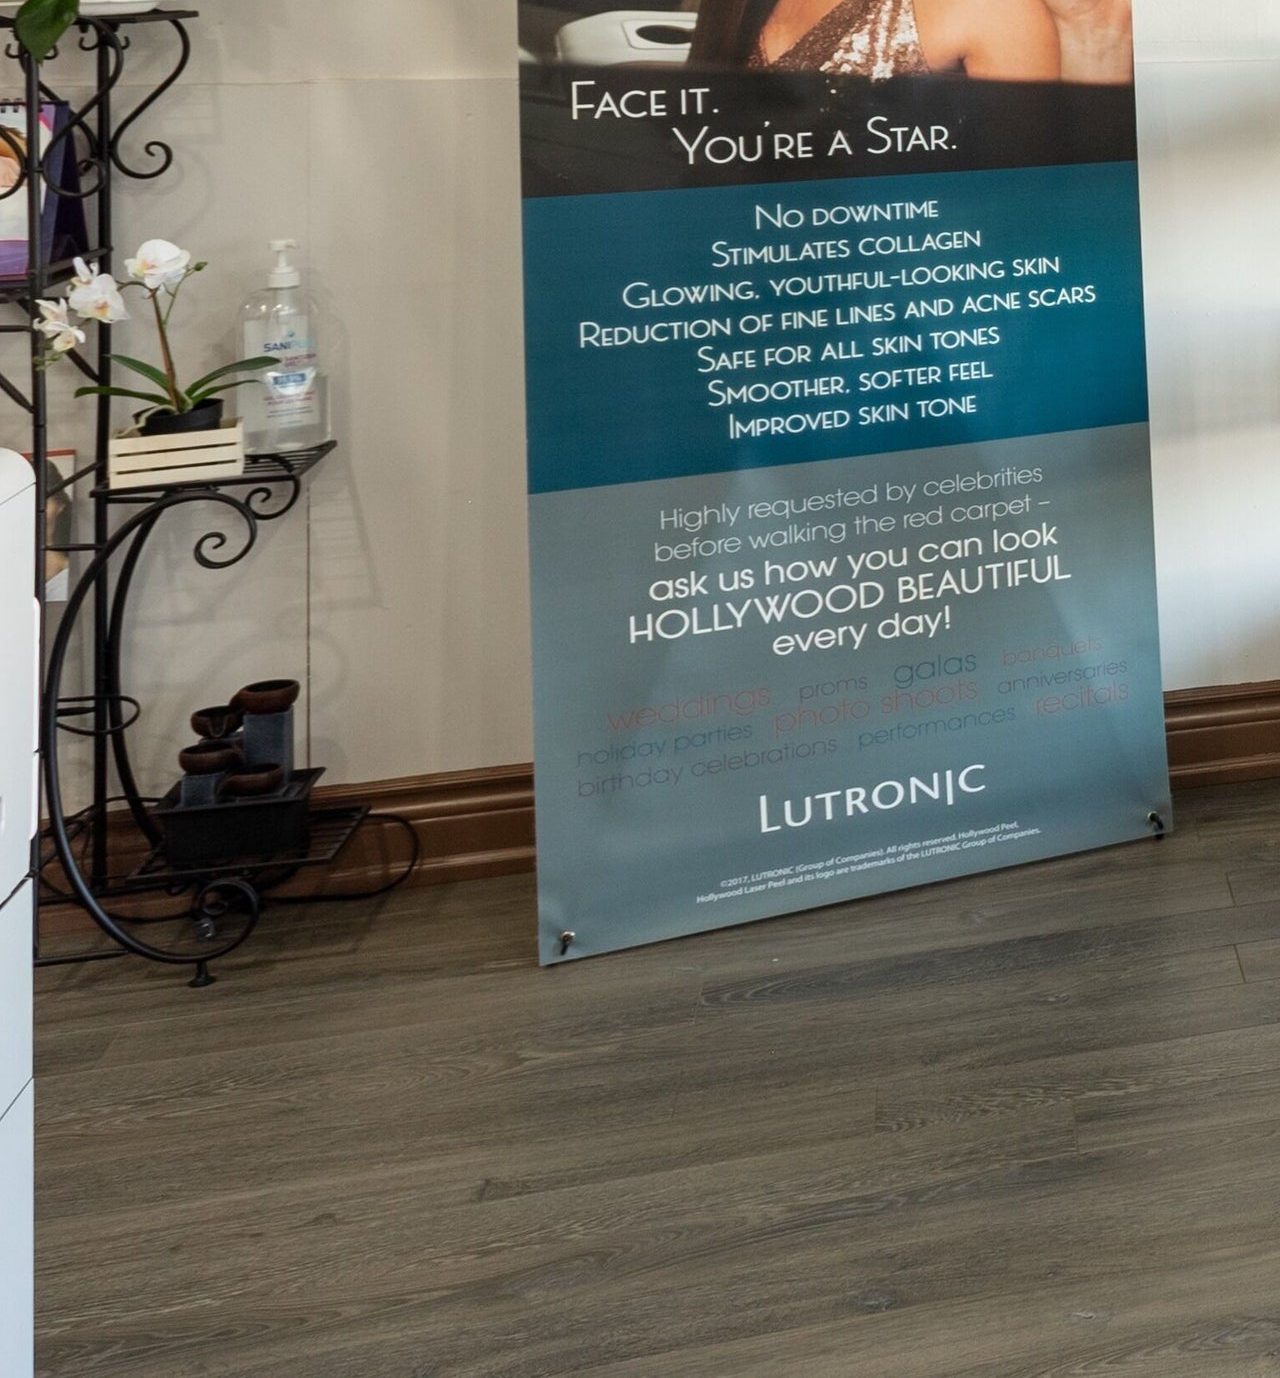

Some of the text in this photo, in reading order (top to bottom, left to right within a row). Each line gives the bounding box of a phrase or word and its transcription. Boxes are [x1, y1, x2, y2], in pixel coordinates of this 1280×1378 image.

[570, 80, 667, 120] FACE
[660, 464, 1043, 530] Highly requested by celebrities
[655, 493, 1032, 563] before walking the red carpet
[648, 523, 1058, 602] ask us how you can look
[628, 555, 1072, 644] HOLLYWOOD BEAUTIFUL
[772, 605, 952, 657] every day!
[1002, 635, 1104, 667] banquets
[800, 674, 868, 706] proms
[894, 653, 977, 690] galas
[998, 659, 1128, 695] anniversaries
[607, 686, 772, 731] weddings
[774, 680, 979, 739] photo shoots
[1034, 681, 1129, 716] recitals
[577, 724, 753, 767] holiday parties
[858, 705, 1016, 751] performances
[577, 738, 838, 798] birthday celebrations
[760, 764, 987, 833] LUTRONIC
[751, 866, 794, 882] LUTRONIC
[825, 857, 835, 867] of
[886, 846, 897, 854] All
[898, 840, 921, 853] rights
[958, 824, 1000, 840] Hollywood
